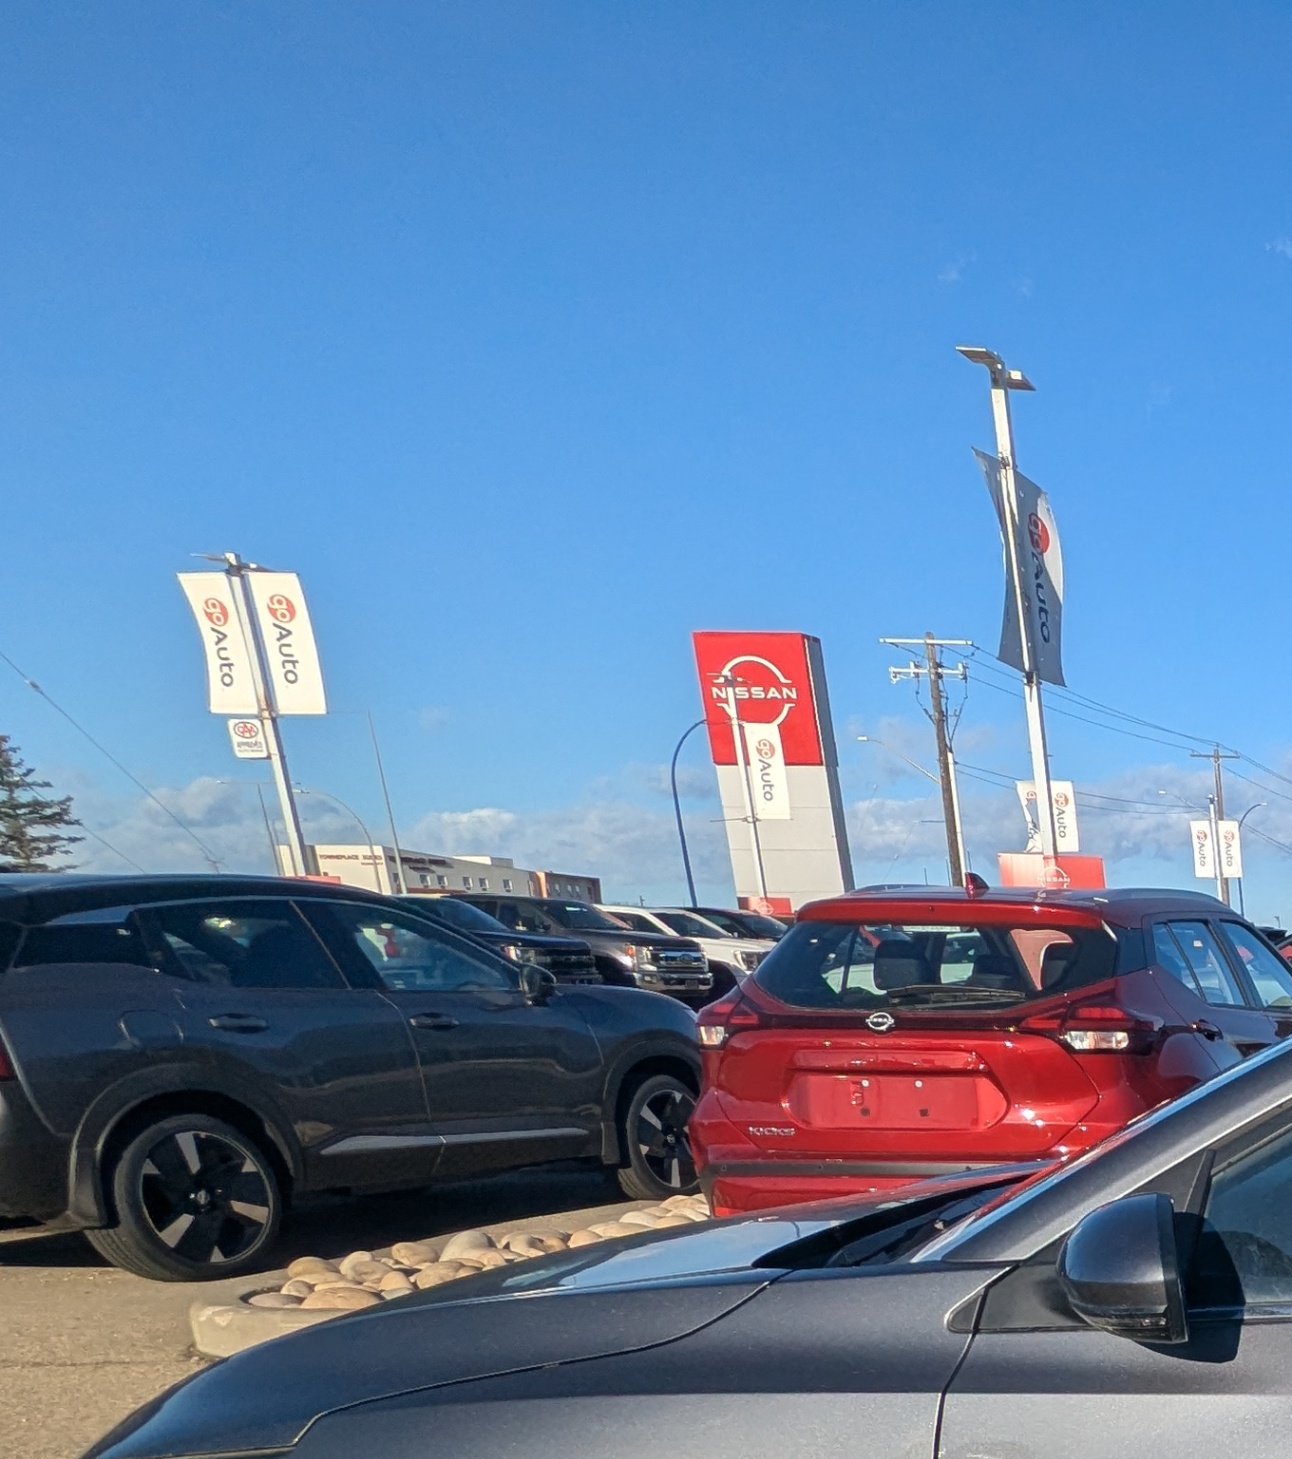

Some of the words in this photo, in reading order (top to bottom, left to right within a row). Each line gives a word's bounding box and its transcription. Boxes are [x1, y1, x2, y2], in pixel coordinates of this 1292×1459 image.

[1032, 551, 1050, 644] Auto
[210, 626, 236, 688] Auto
[272, 622, 300, 685] Auto
[711, 686, 798, 699] NSSAN
[758, 758, 776, 802] Auto
[1056, 806, 1068, 839] Auto
[1198, 841, 1207, 868] Auto
[1225, 841, 1234, 868] Auto
